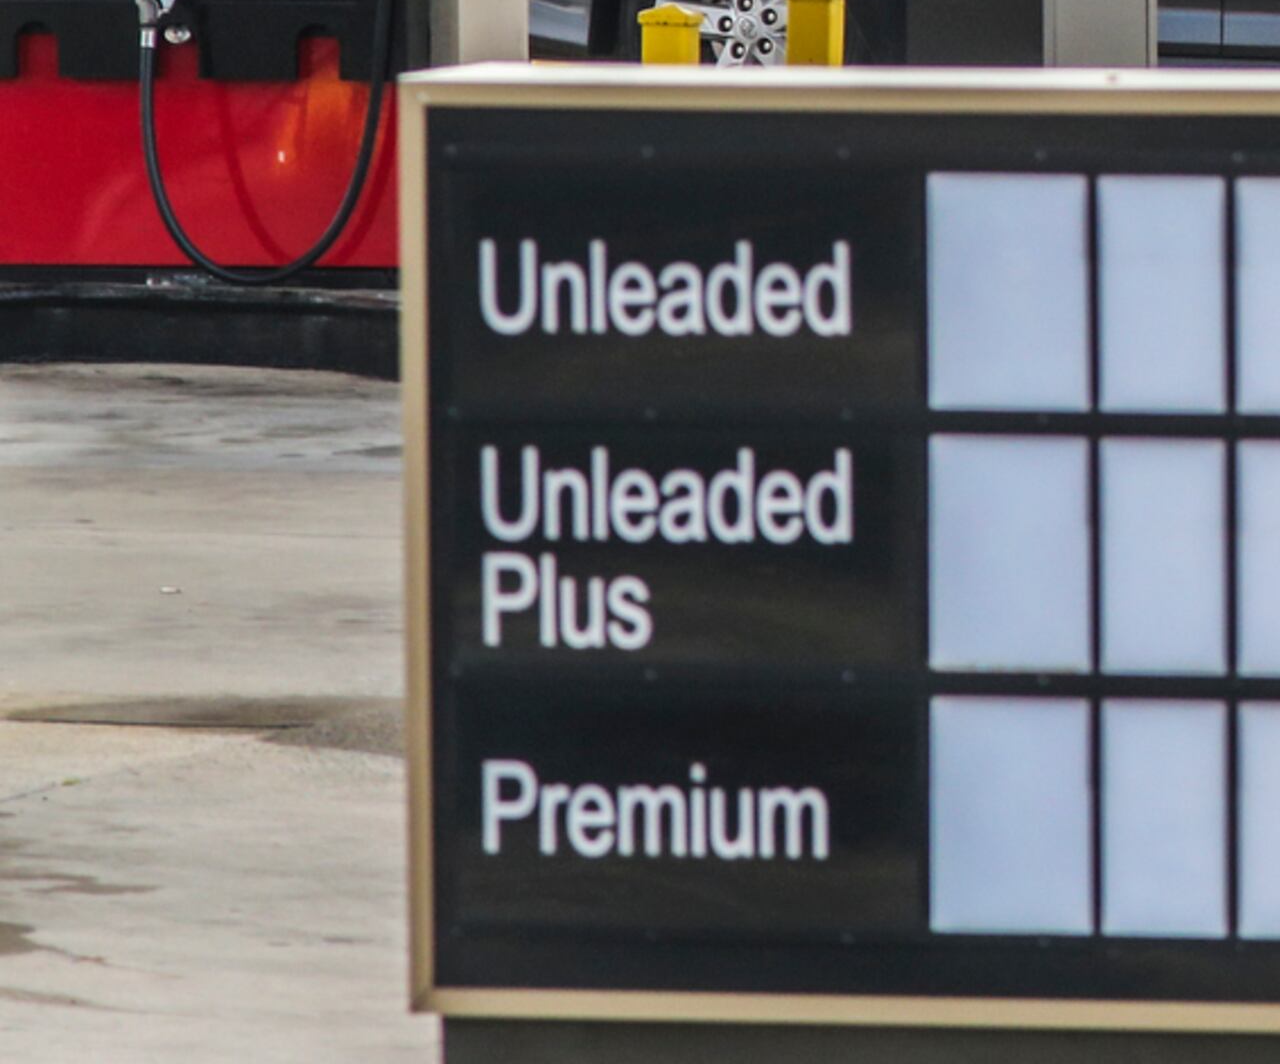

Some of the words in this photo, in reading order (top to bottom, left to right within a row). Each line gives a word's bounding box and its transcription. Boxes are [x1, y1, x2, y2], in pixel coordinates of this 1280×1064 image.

[478, 238, 852, 338] Unleaded
[480, 446, 854, 545] Unleaded
[481, 551, 653, 652] Plus
[481, 758, 830, 860] Premium
